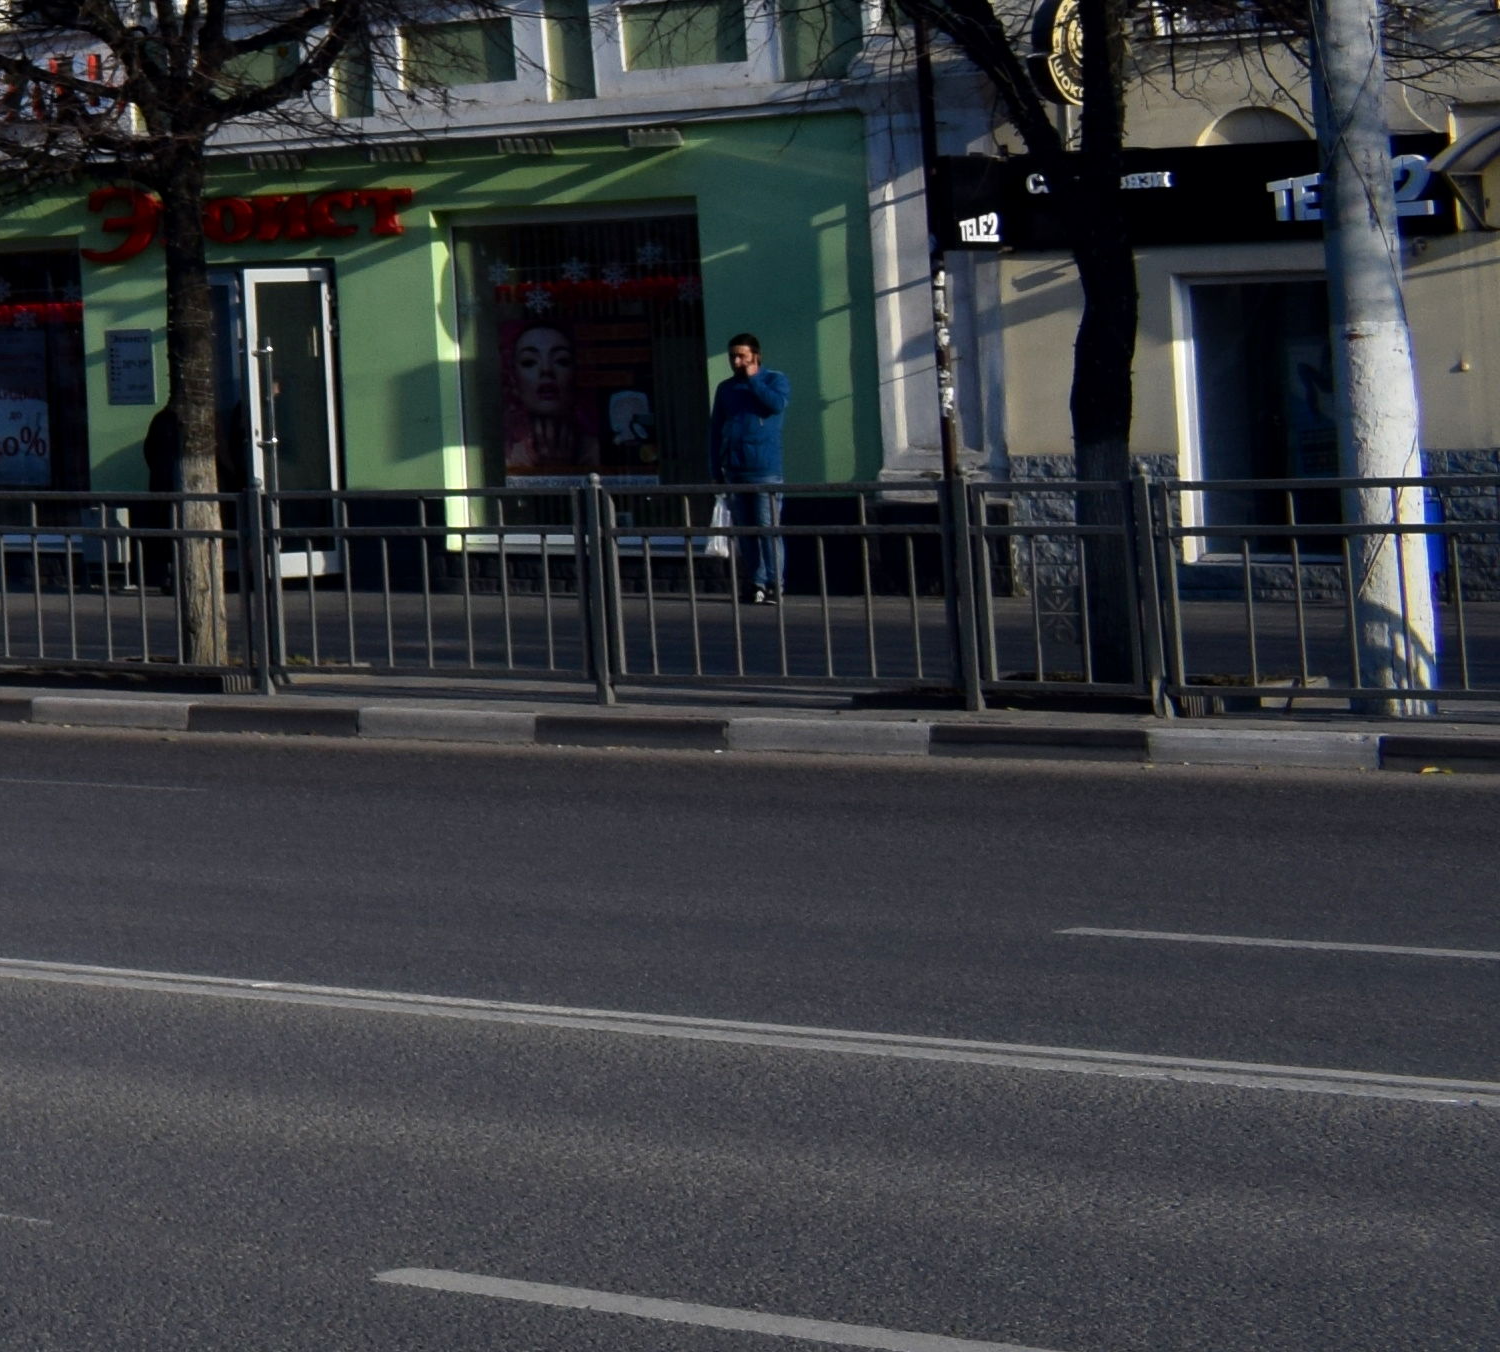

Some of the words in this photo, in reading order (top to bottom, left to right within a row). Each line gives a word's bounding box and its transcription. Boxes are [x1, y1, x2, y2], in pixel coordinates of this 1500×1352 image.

[1266, 154, 1436, 222] TE2
[81, 185, 414, 263] Эоист
[959, 212, 1001, 243] TELE2
